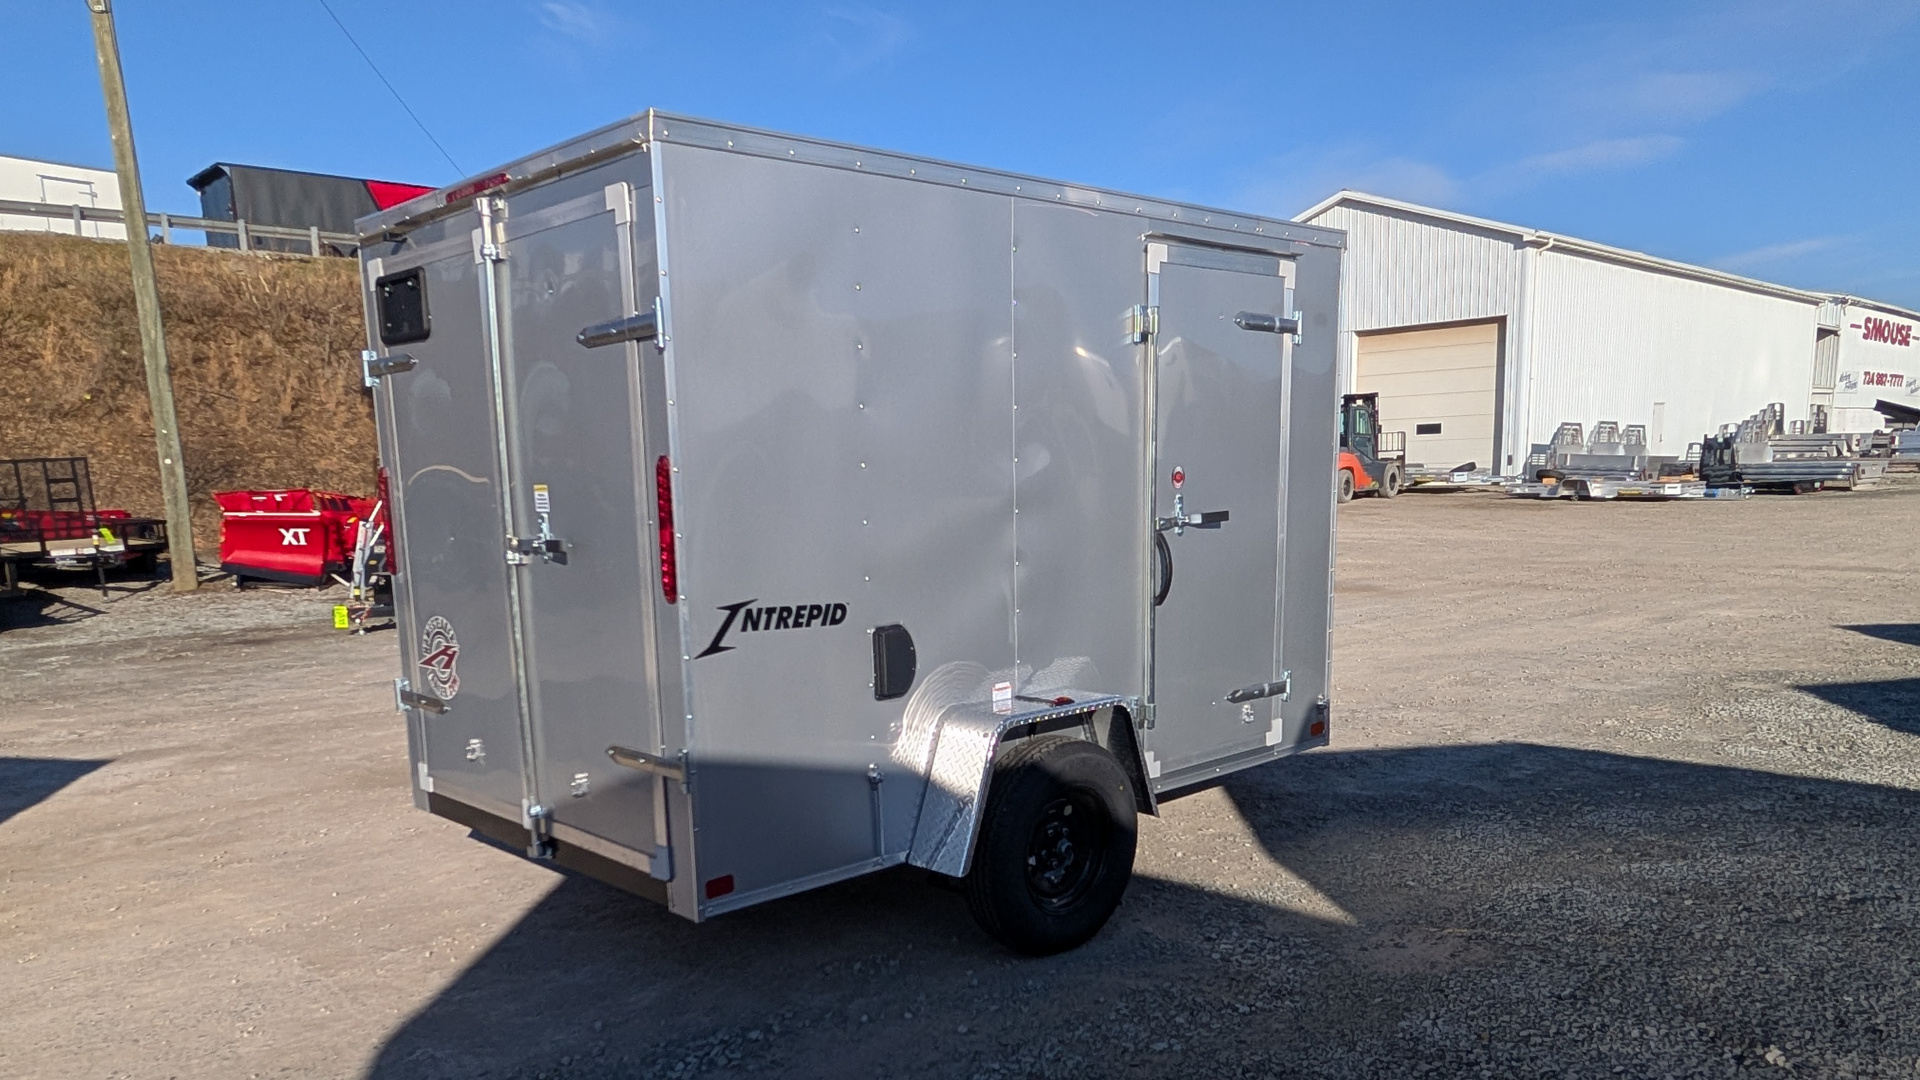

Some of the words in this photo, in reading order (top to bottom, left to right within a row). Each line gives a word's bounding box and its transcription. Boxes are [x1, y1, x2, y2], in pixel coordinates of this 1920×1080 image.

[1862, 316, 1912, 347] SMOUSE
[1863, 371, 1875, 386] 724
[278, 528, 310, 546] XT
[694, 598, 848, 660] INTREPID
